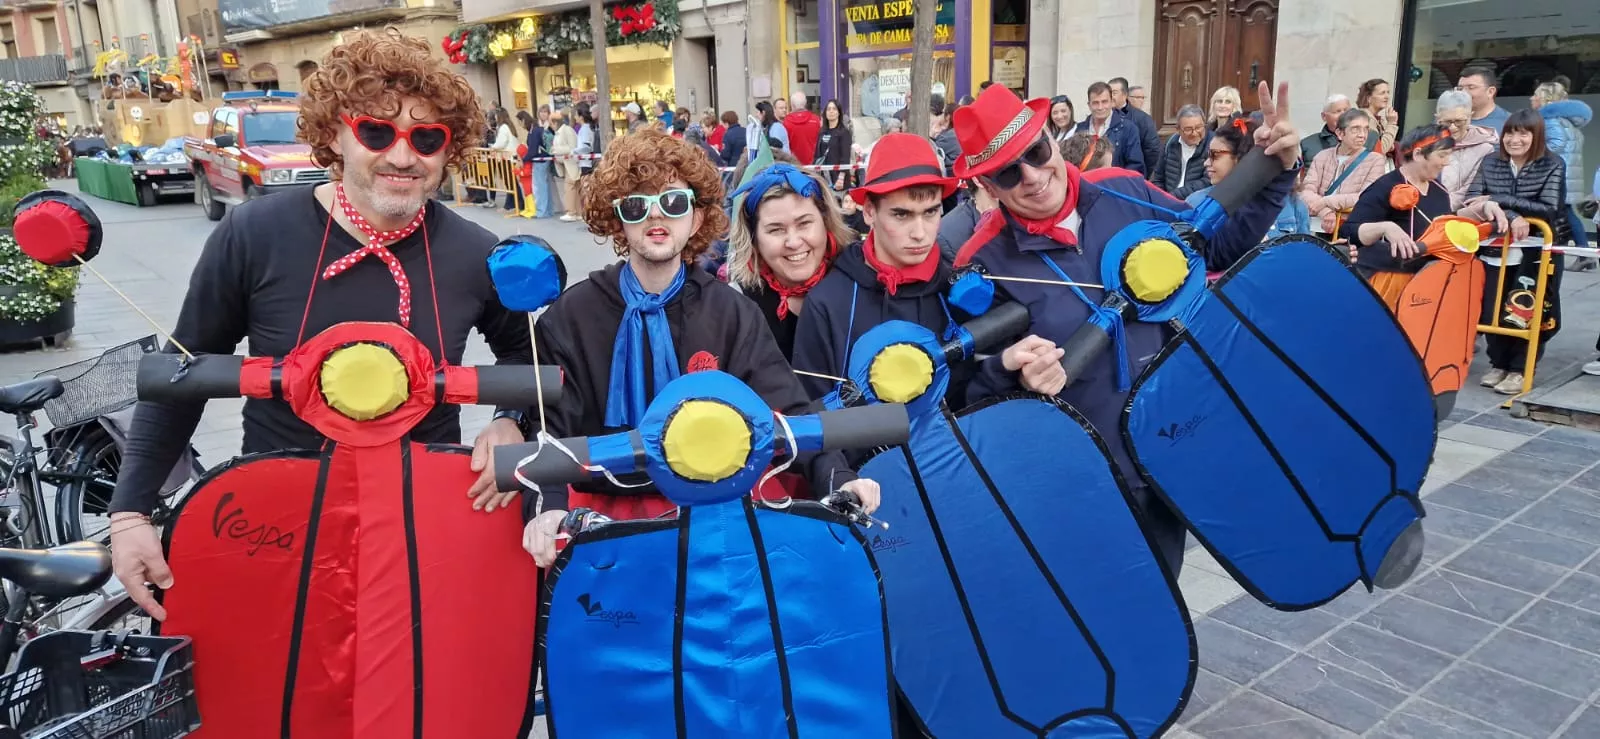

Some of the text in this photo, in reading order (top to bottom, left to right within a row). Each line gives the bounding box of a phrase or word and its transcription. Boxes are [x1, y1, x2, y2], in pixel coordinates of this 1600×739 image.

[846, 5, 880, 22] VENTA
[846, 33, 867, 48] PA
[870, 31, 882, 44] DE
[884, 28, 911, 42] CAMA
[880, 74, 911, 87] DESCUEN
[1157, 415, 1203, 441] Vespa
[212, 492, 295, 557] Vespa
[576, 592, 637, 628] Vespa
